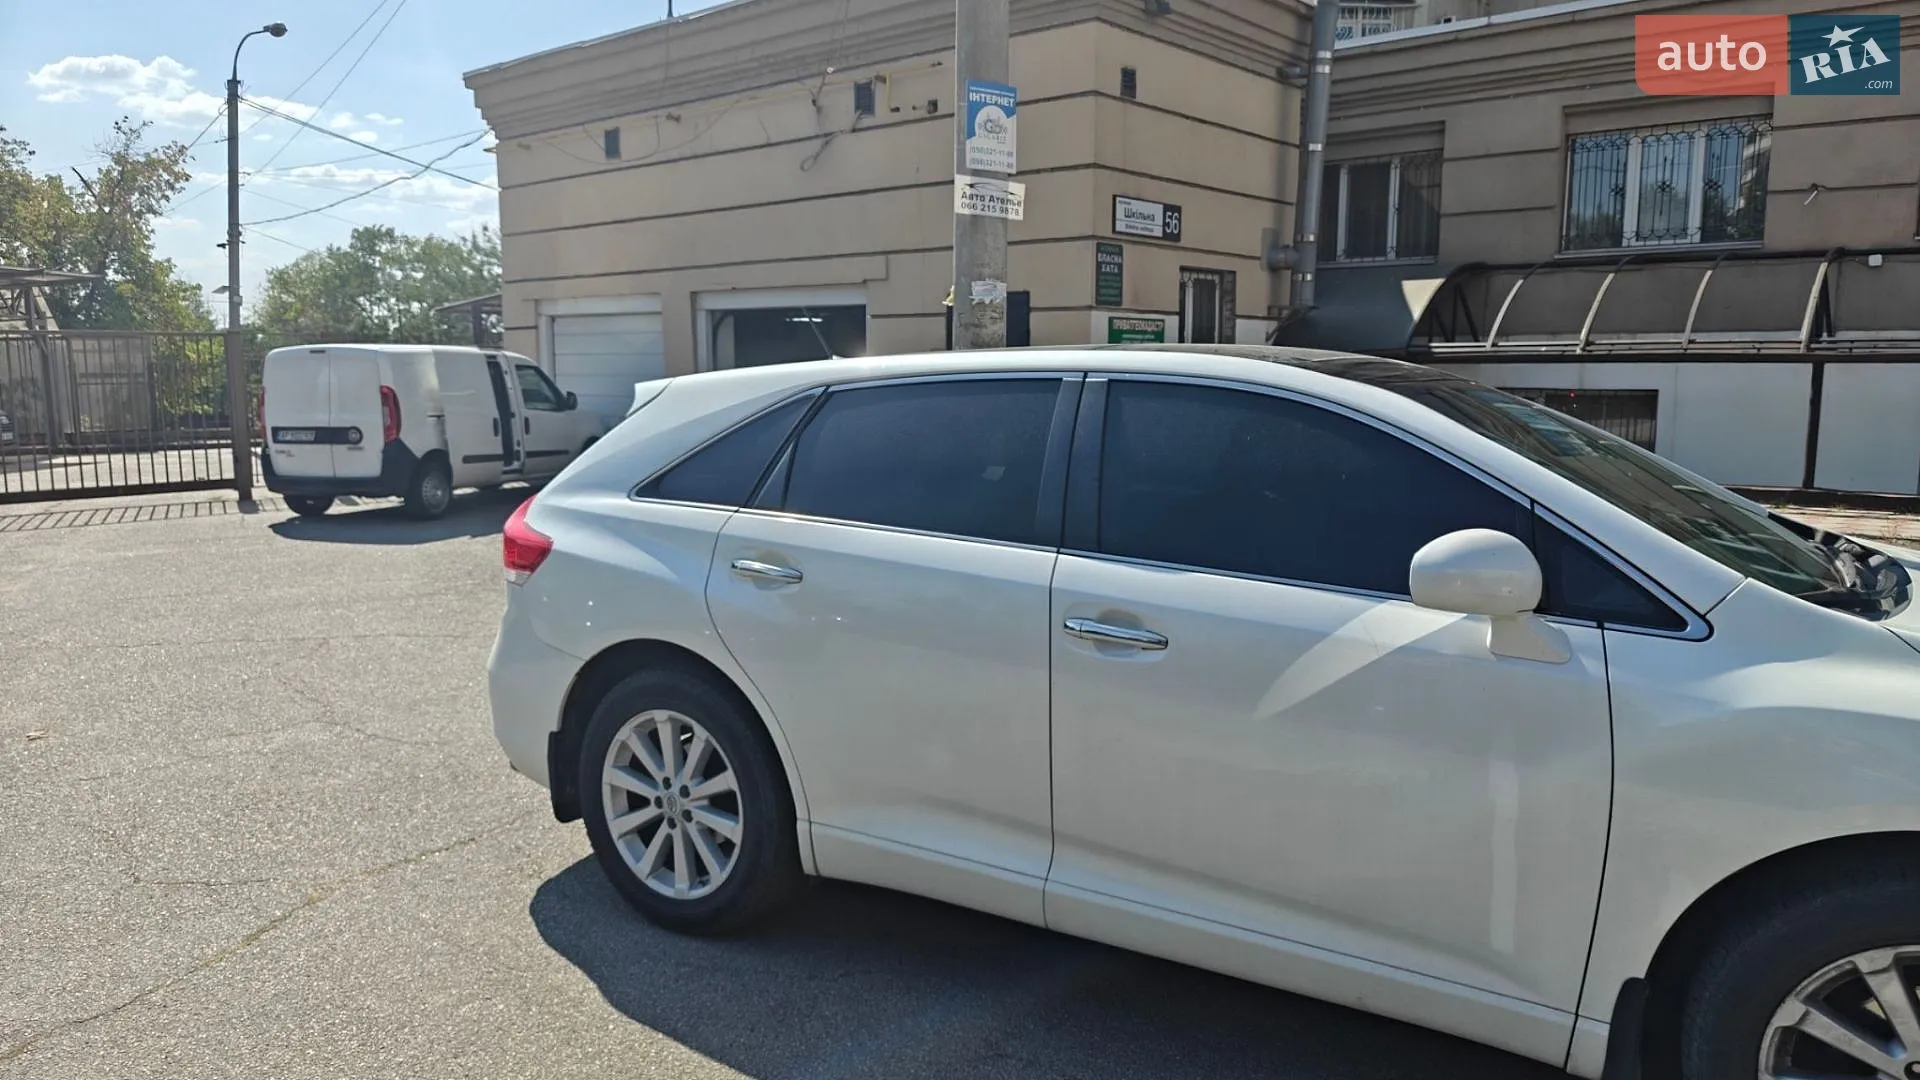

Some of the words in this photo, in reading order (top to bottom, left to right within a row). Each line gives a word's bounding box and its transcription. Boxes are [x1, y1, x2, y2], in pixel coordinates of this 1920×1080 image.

[969, 91, 1015, 107] ІНТЕРНЕТ
[961, 190, 986, 203] Авто
[988, 194, 1022, 208] Ателье
[961, 202, 978, 212] 066
[980, 203, 997, 213] 215
[999, 206, 1019, 217] 9878
[1124, 206, 1156, 222] Шкільна
[1165, 211, 1180, 234] 56
[1097, 252, 1122, 264] ВЛАСНА
[1101, 263, 1119, 273] ХАТА
